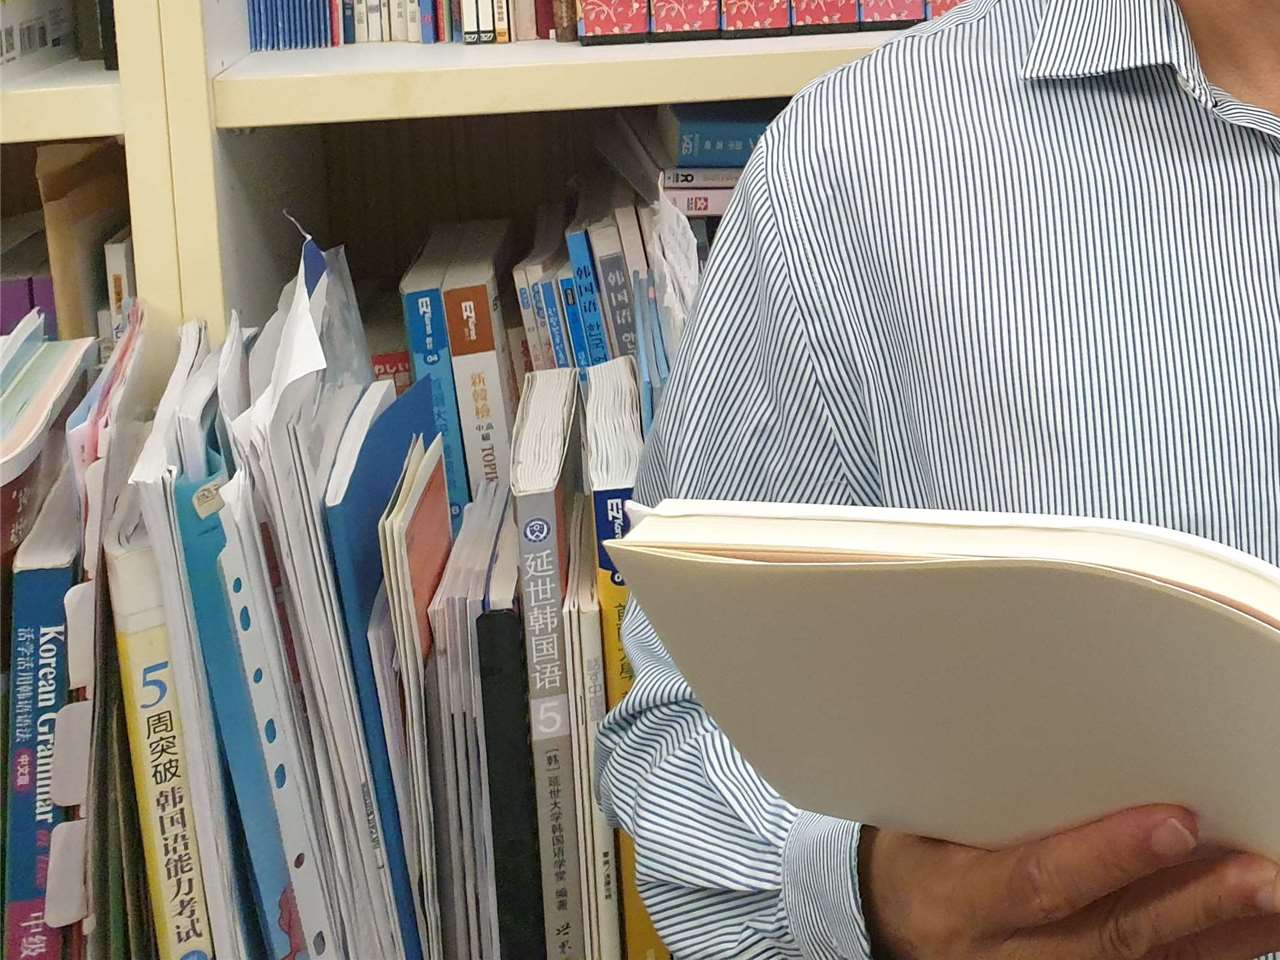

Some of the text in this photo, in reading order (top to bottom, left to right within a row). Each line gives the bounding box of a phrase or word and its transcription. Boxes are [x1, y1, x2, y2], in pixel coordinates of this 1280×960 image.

[524, 552, 561, 690] 延世韩国语
[36, 624, 66, 823] Korean Grammar
[538, 701, 561, 732] 5
[140, 661, 204, 945] 5 周突破 韩国语能力考试
